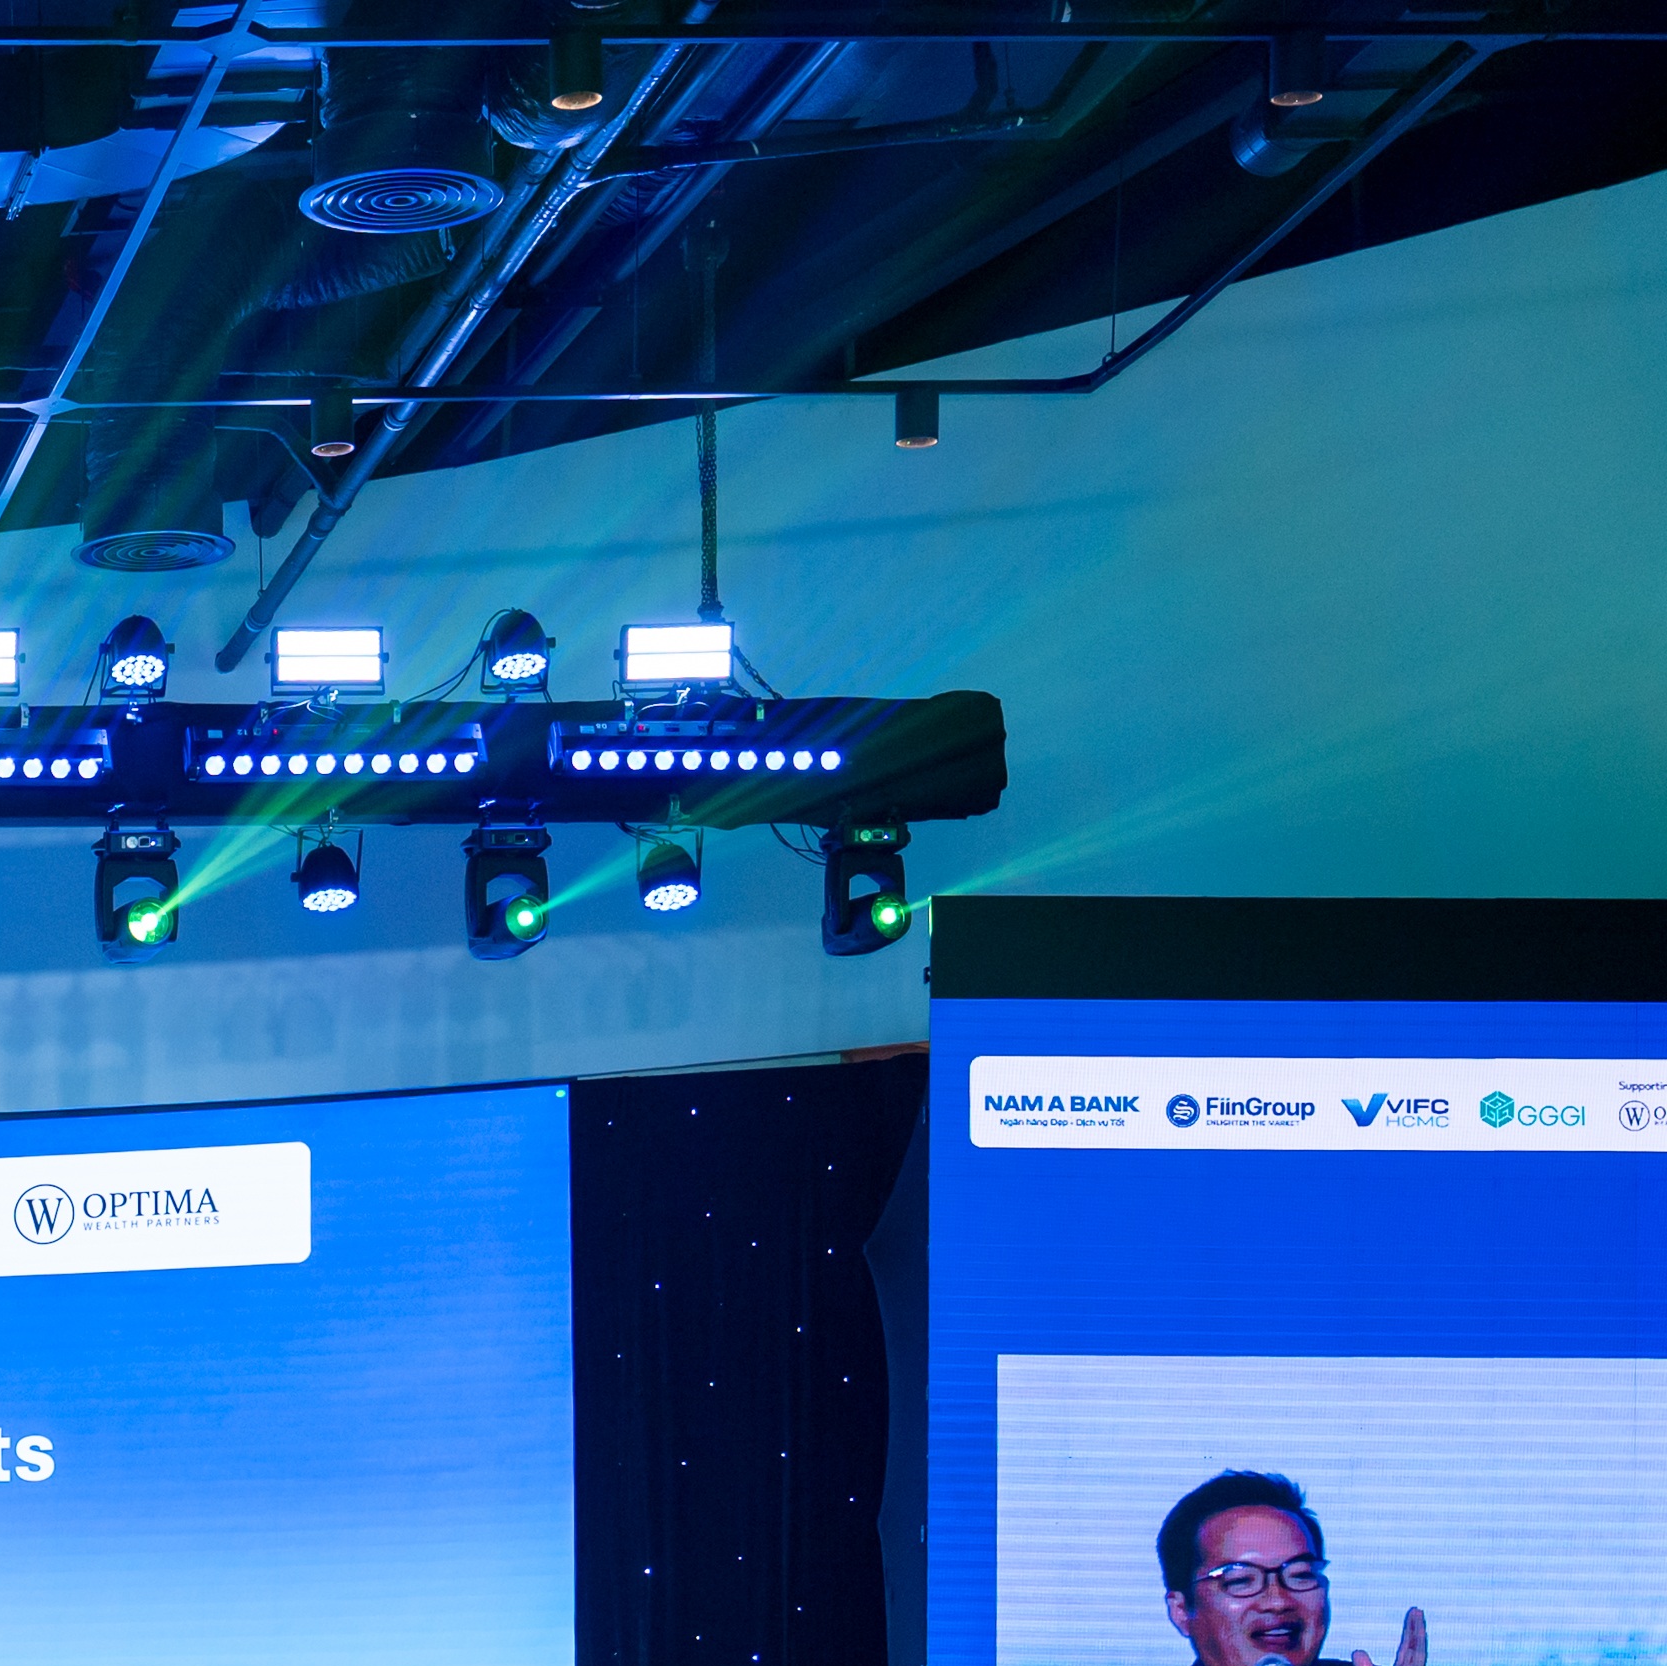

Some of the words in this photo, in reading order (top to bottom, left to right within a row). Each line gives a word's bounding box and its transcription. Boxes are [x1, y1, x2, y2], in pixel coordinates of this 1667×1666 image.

[985, 1095, 1043, 1111] NAM
[1048, 1096, 1065, 1111] A
[1071, 1096, 1139, 1112] BANK
[1207, 1097, 1315, 1124] FiinGroup
[1386, 1098, 1450, 1115] VIFC
[1386, 1116, 1449, 1128] HCMC
[1518, 1106, 1585, 1126] GGGI
[82, 1187, 219, 1220] OPTIMA
[83, 1218, 139, 1232] WEALTH
[146, 1214, 220, 1229] PARTNERS
